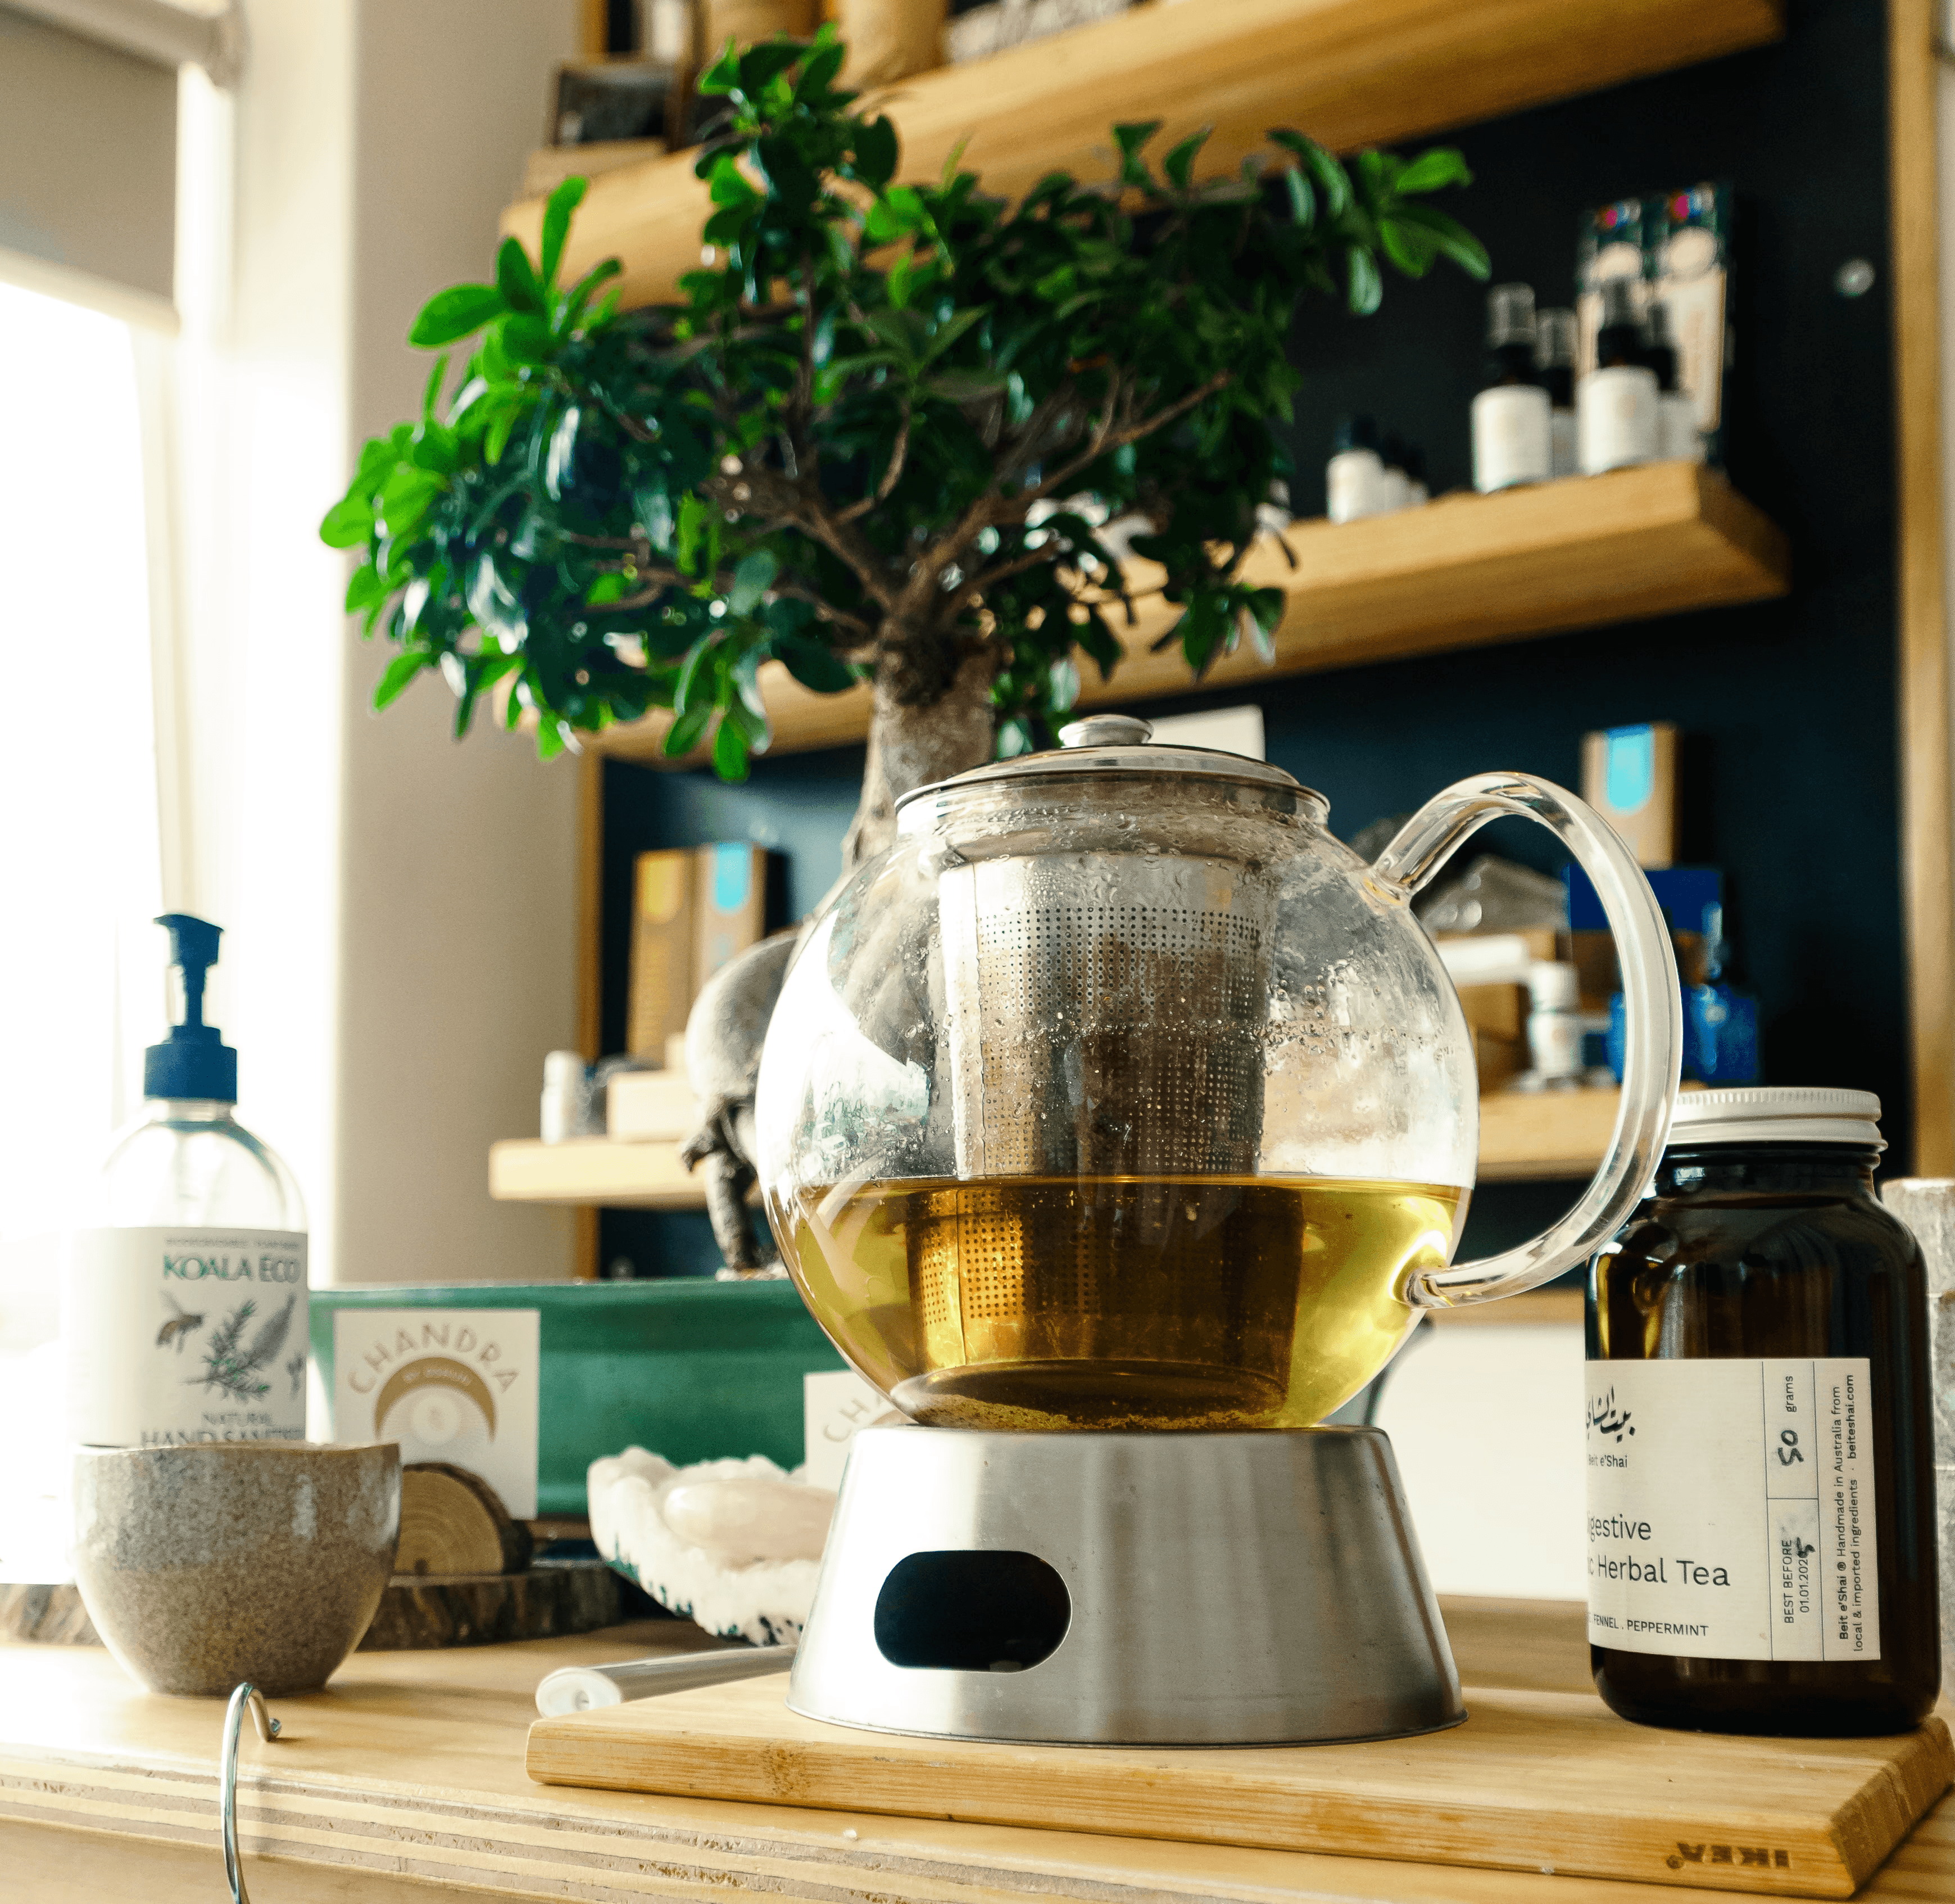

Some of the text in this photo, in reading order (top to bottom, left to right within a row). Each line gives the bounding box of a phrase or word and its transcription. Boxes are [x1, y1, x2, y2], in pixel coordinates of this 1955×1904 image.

[163, 1253, 301, 1284] KOALA ECO
[347, 1322, 520, 1394] CHANDRA
[1831, 1386, 1841, 1415] from
[1777, 1375, 1804, 1466] 50 grams
[1600, 1453, 1627, 1468] e'Shai
[1831, 1418, 1844, 1472] Australia
[1833, 1476, 1844, 1487] in
[1834, 1492, 1846, 1557] Handmade
[1845, 1375, 1864, 1652] local & imported ingredients beiteshai.com
[1598, 1553, 1668, 1584] Herbal
[1676, 1560, 1731, 1586] Tea
[1781, 1540, 1794, 1624] BEST BEFORE
[1836, 1576, 1848, 1612] e'Shai
[1594, 1613, 1619, 1629] FENNEL
[1626, 1619, 1709, 1636] PEPPERMINT
[1838, 1615, 1849, 1640] Beit
[1676, 1841, 1790, 1870] IKEA
